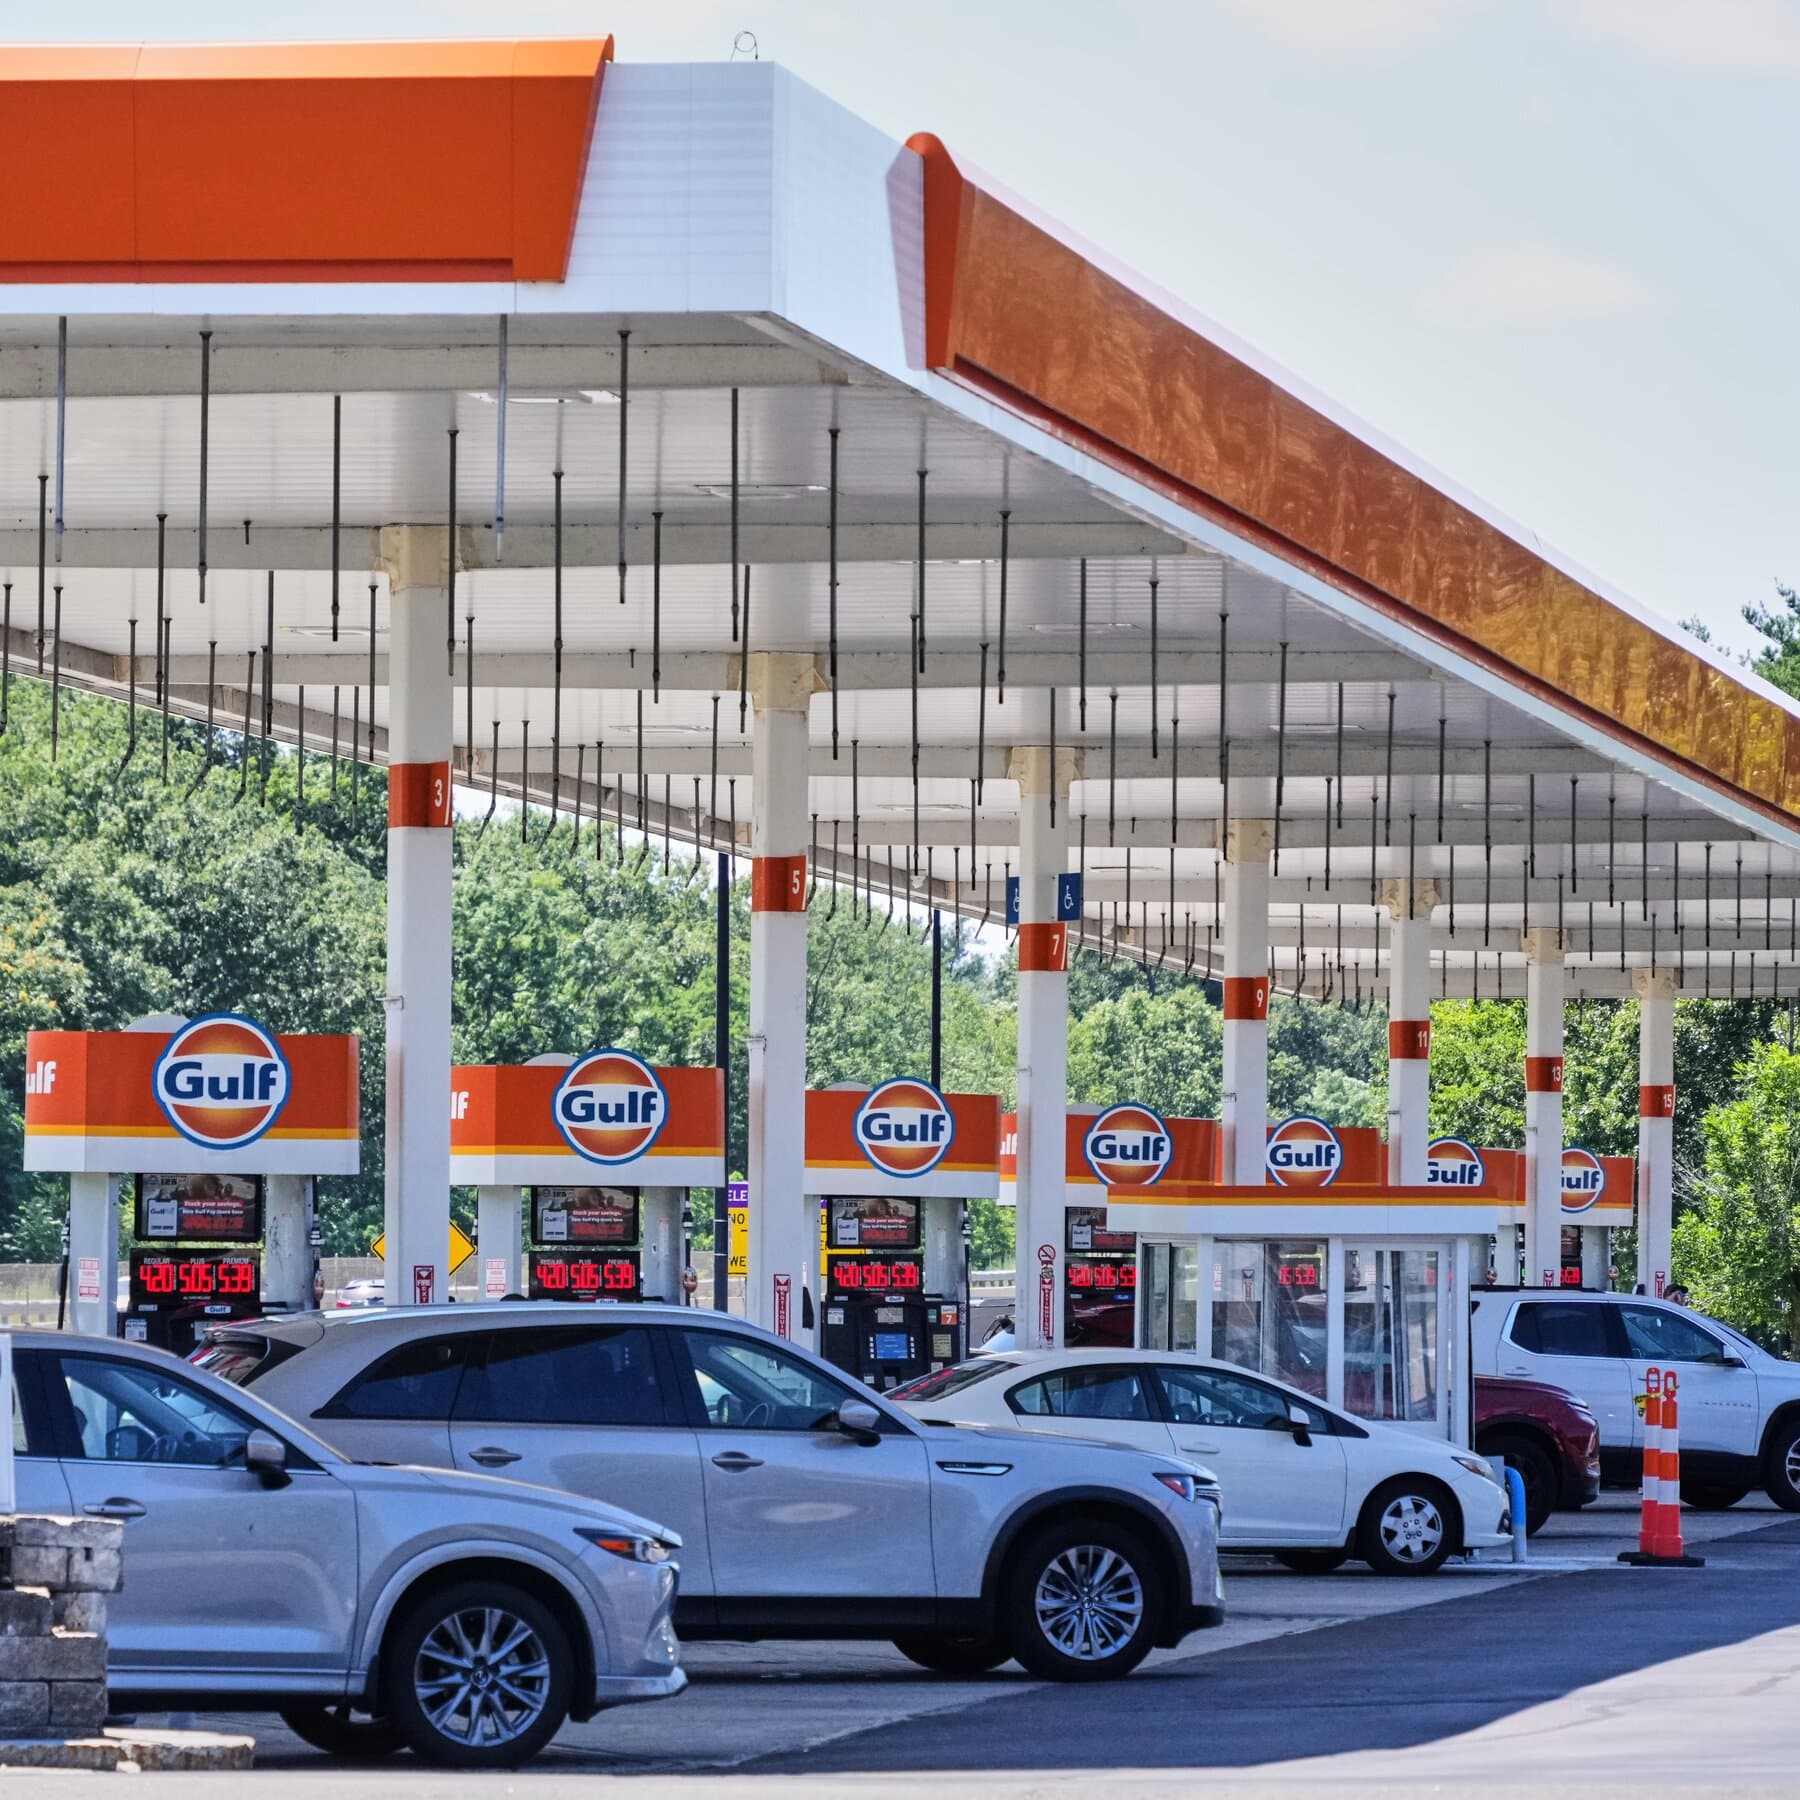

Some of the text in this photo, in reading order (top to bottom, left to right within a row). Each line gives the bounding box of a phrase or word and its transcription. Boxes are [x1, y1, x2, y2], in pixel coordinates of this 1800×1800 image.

[434, 778, 443, 807] 3
[791, 869, 800, 895] 5
[1052, 934, 1060, 956] 7
[1256, 988, 1264, 1008] 9
[1417, 1030, 1428, 1049] 11
[26, 1061, 57, 1094] ulf
[163, 1061, 278, 1100] Gulf
[1551, 1066, 1562, 1083] 13
[451, 1091, 469, 1120] lf
[561, 1090, 657, 1123] Gulf
[1663, 1093, 1673, 1109] 15
[861, 1112, 946, 1142] Gulf
[1091, 1134, 1166, 1162] Gulf
[1268, 1143, 1336, 1168] Gulf
[1428, 1161, 1479, 1184] Gulf
[1561, 1170, 1600, 1189] ulf
[945, 1314, 953, 1324] 7
